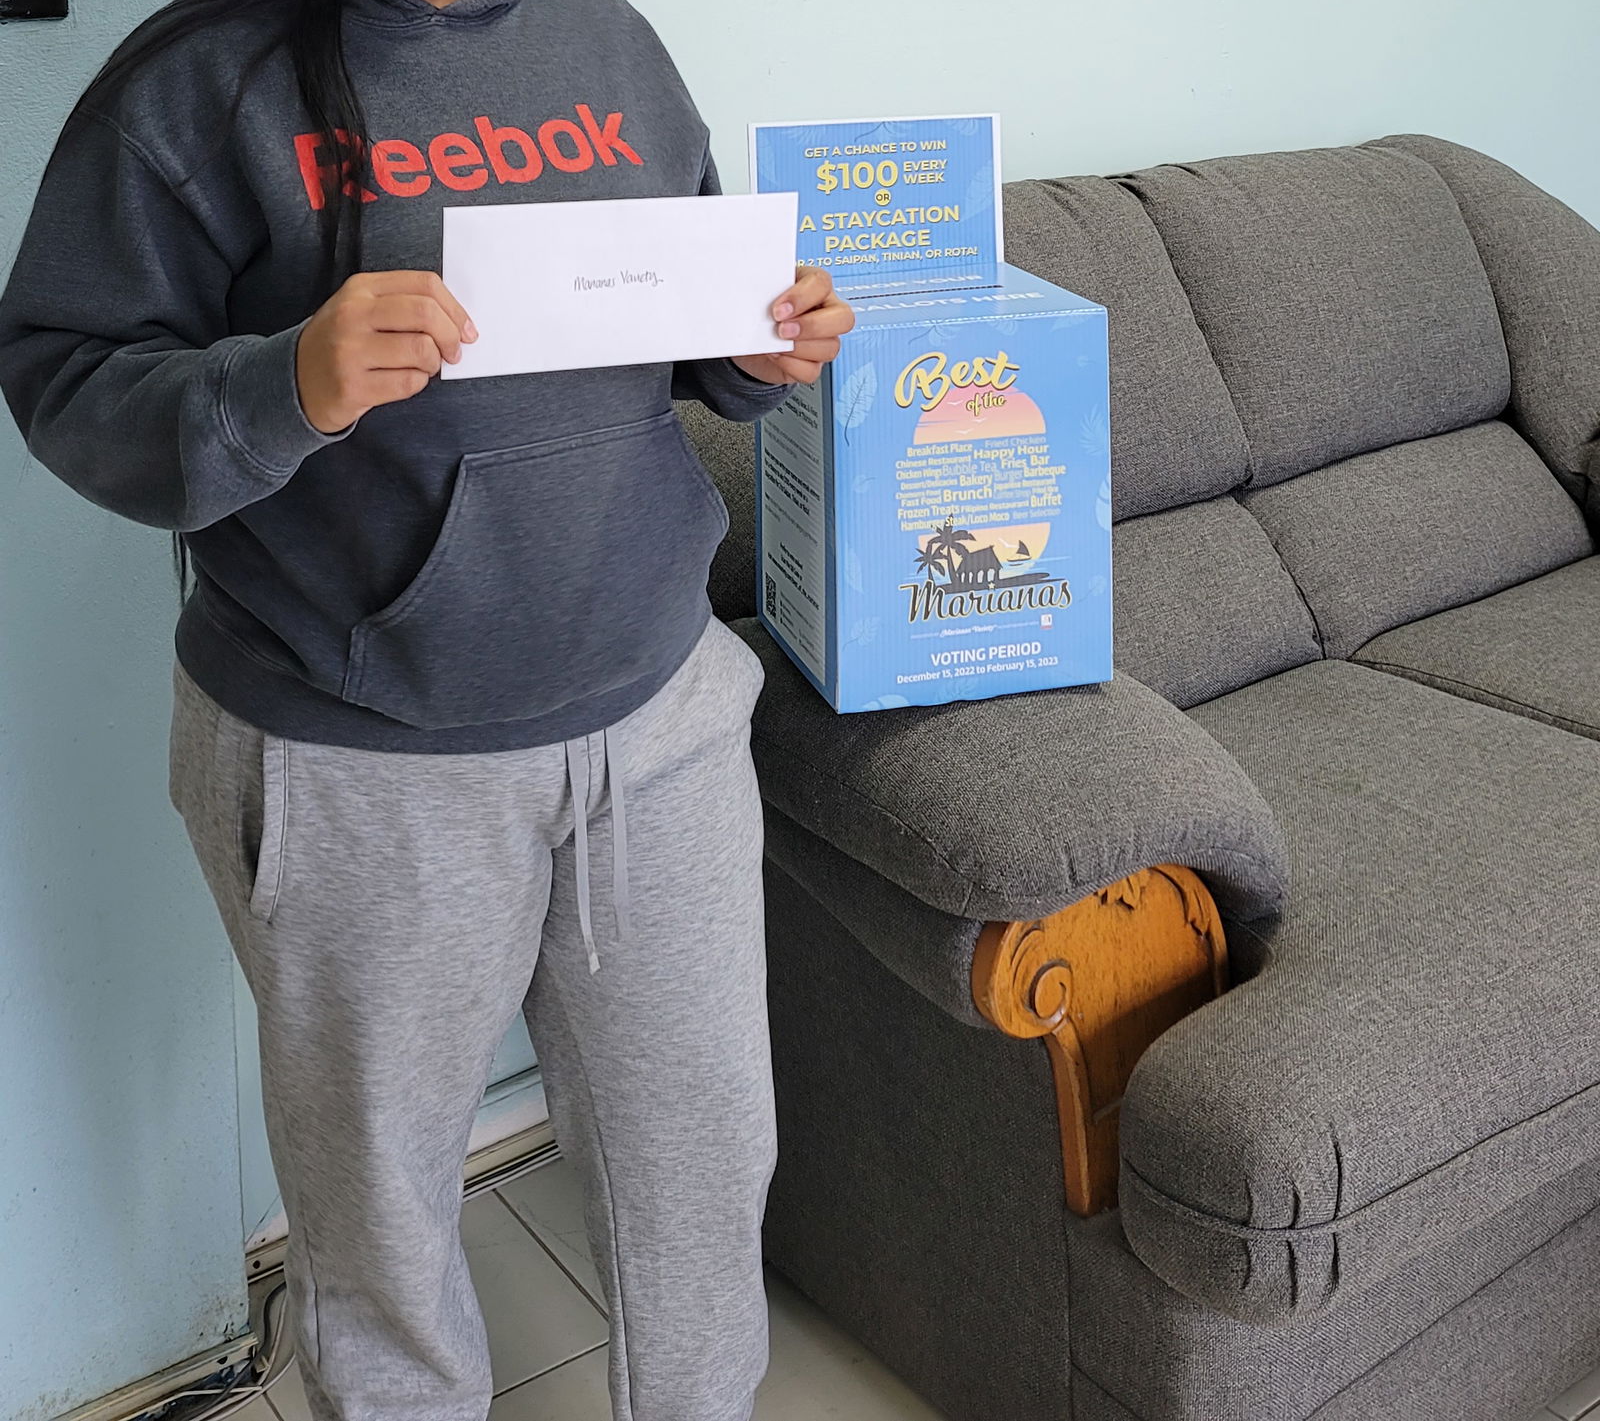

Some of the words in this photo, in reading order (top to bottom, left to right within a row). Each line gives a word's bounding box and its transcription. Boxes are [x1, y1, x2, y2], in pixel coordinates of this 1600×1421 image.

[293, 103, 645, 210] Reebok
[804, 146, 830, 158] GET
[832, 146, 842, 157] A
[845, 142, 897, 156] CHANCE
[900, 141, 918, 153] TO
[920, 140, 947, 151] WIN
[903, 159, 947, 173] EVERY
[816, 160, 898, 195] $100
[904, 172, 946, 185] WEEK
[876, 192, 891, 202] OR
[799, 215, 817, 233] A
[822, 204, 960, 231] STAYCATION
[825, 229, 931, 253] PACKAGE
[817, 257, 832, 266] TO
[835, 254, 880, 266] SAIPAN,
[882, 251, 922, 263] TINIAN,
[925, 249, 942, 258] OR
[944, 247, 978, 257] ROTA!
[835, 280, 907, 292] DROP
[914, 274, 983, 285] YOUR
[852, 297, 967, 313] BALLOTS
[973, 291, 1044, 304] HERE
[894, 350, 1020, 412] Best
[966, 393, 983, 417] of
[983, 393, 1006, 408] the
[907, 445, 949, 457] Breakfast
[950, 443, 973, 454] Place
[985, 439, 1008, 448] Fried
[1010, 437, 1046, 446] Chicken
[974, 448, 1015, 461] Happy
[1018, 445, 1049, 455] Hour
[1031, 455, 1050, 466] Bar
[942, 464, 977, 477] Bubble
[979, 461, 997, 472] Tea
[1001, 459, 1026, 469] Fries
[1024, 465, 1066, 478] Barbeque
[959, 474, 993, 487] Bakery
[943, 486, 992, 502] Brunch
[1031, 493, 1062, 508] Buffet
[901, 499, 919, 508] Fast
[920, 497, 941, 506] Food
[898, 508, 930, 519] Frozen
[931, 505, 960, 516] Treats
[898, 578, 1072, 624] Marianas
[931, 647, 986, 667] VOTING
[989, 641, 1042, 660] PERIOD
[897, 671, 940, 684] December
[942, 669, 953, 680] 15,
[953, 665, 975, 676] 2022
[976, 665, 985, 675] to
[987, 660, 1025, 673] February
[1026, 659, 1037, 669] 15,
[1038, 656, 1059, 667] 2023
